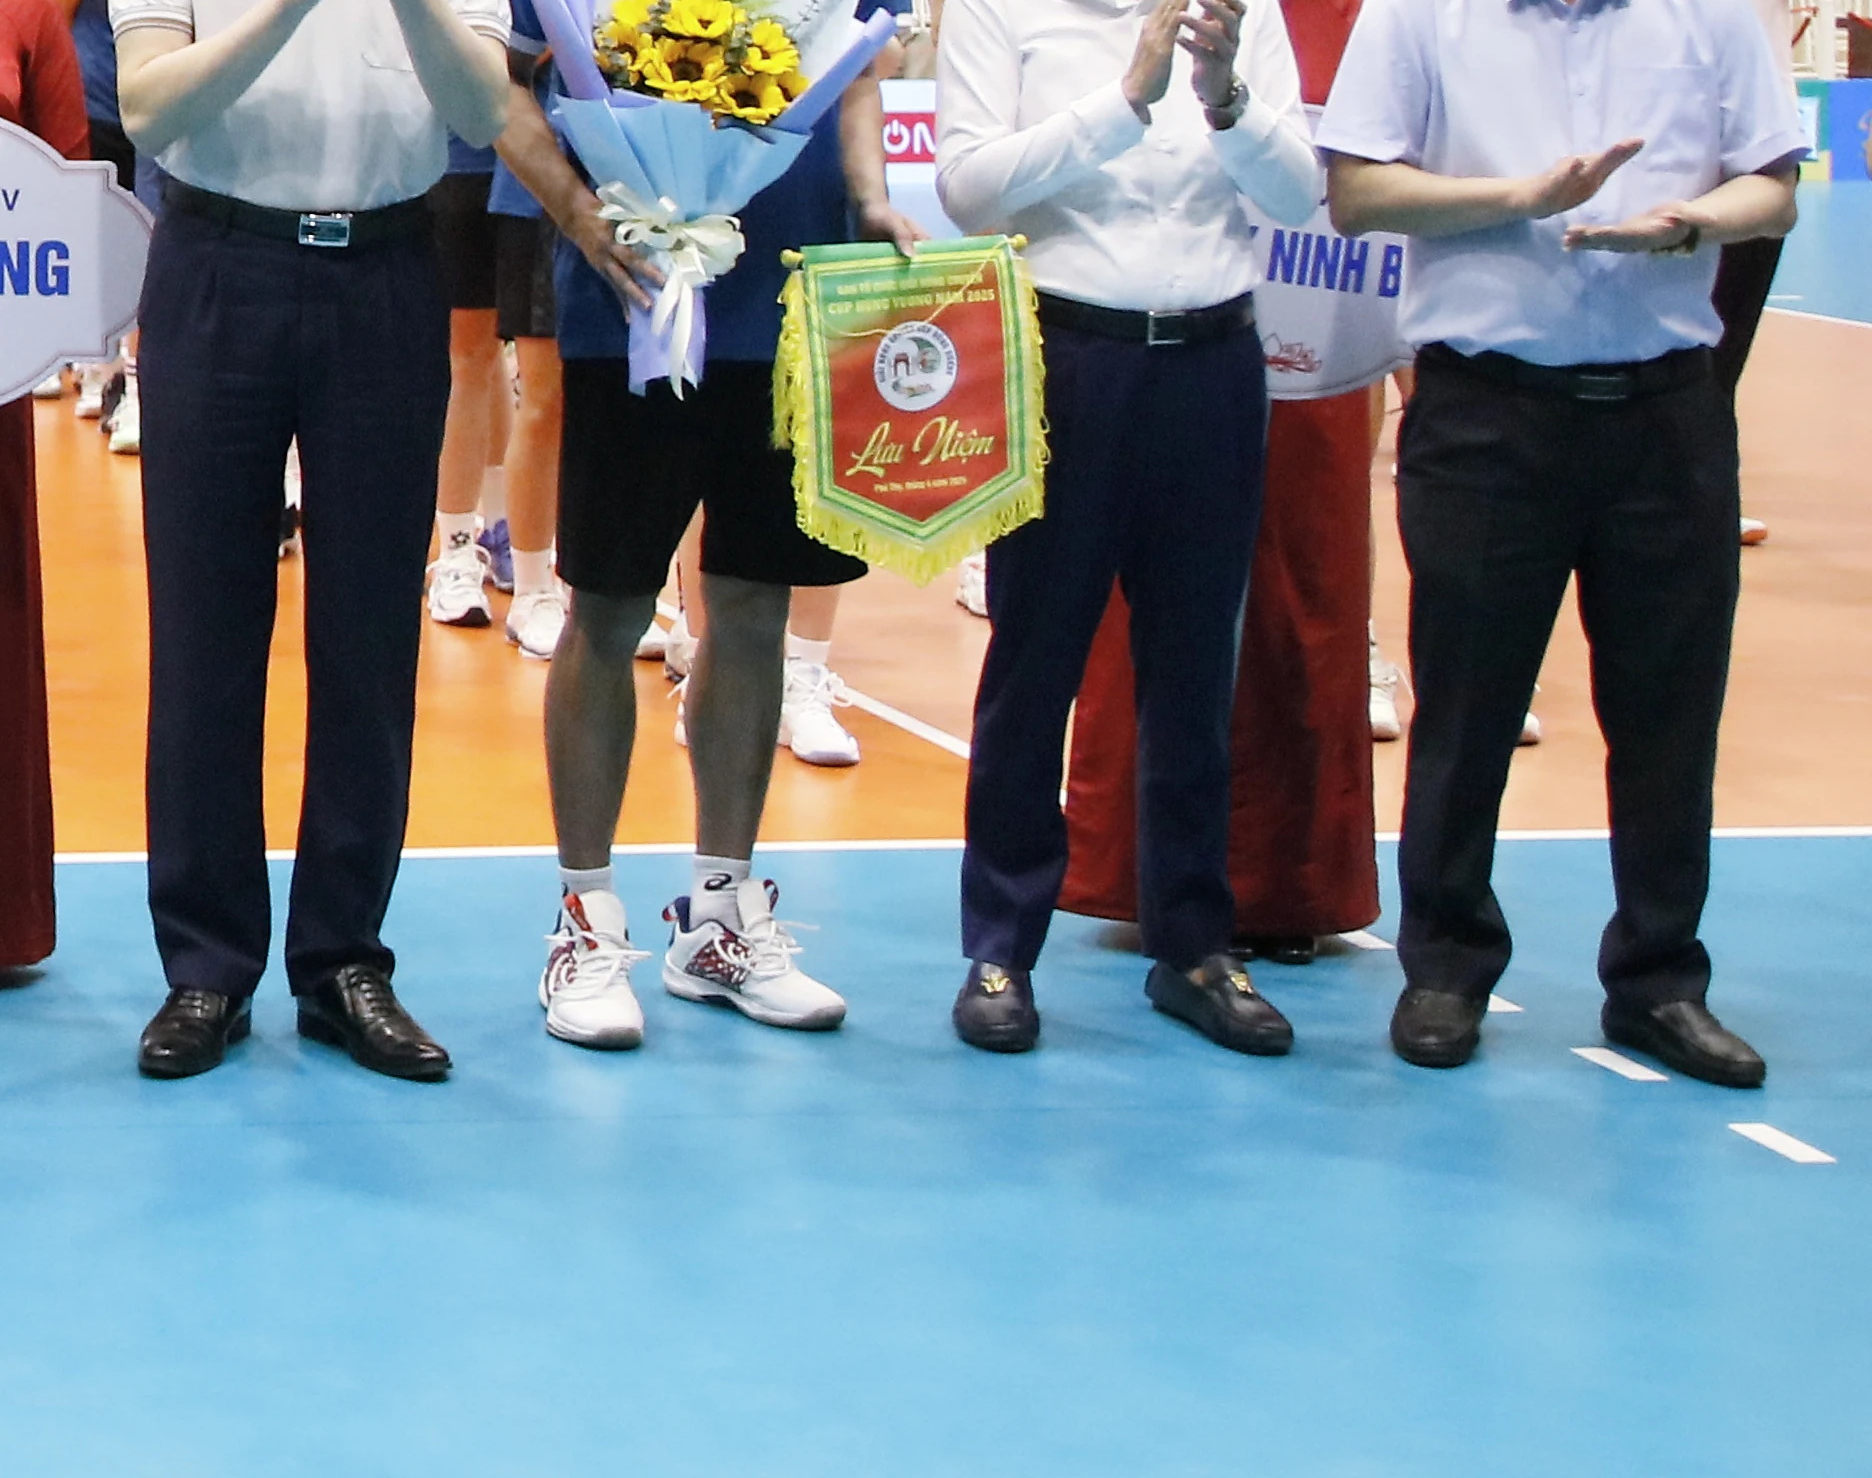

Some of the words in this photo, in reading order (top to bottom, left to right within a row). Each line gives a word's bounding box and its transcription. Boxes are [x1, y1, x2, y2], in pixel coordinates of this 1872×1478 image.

[1266, 228, 1370, 294] NINH
[845, 421, 904, 479] Lưu
[911, 415, 996, 465] Niệm
